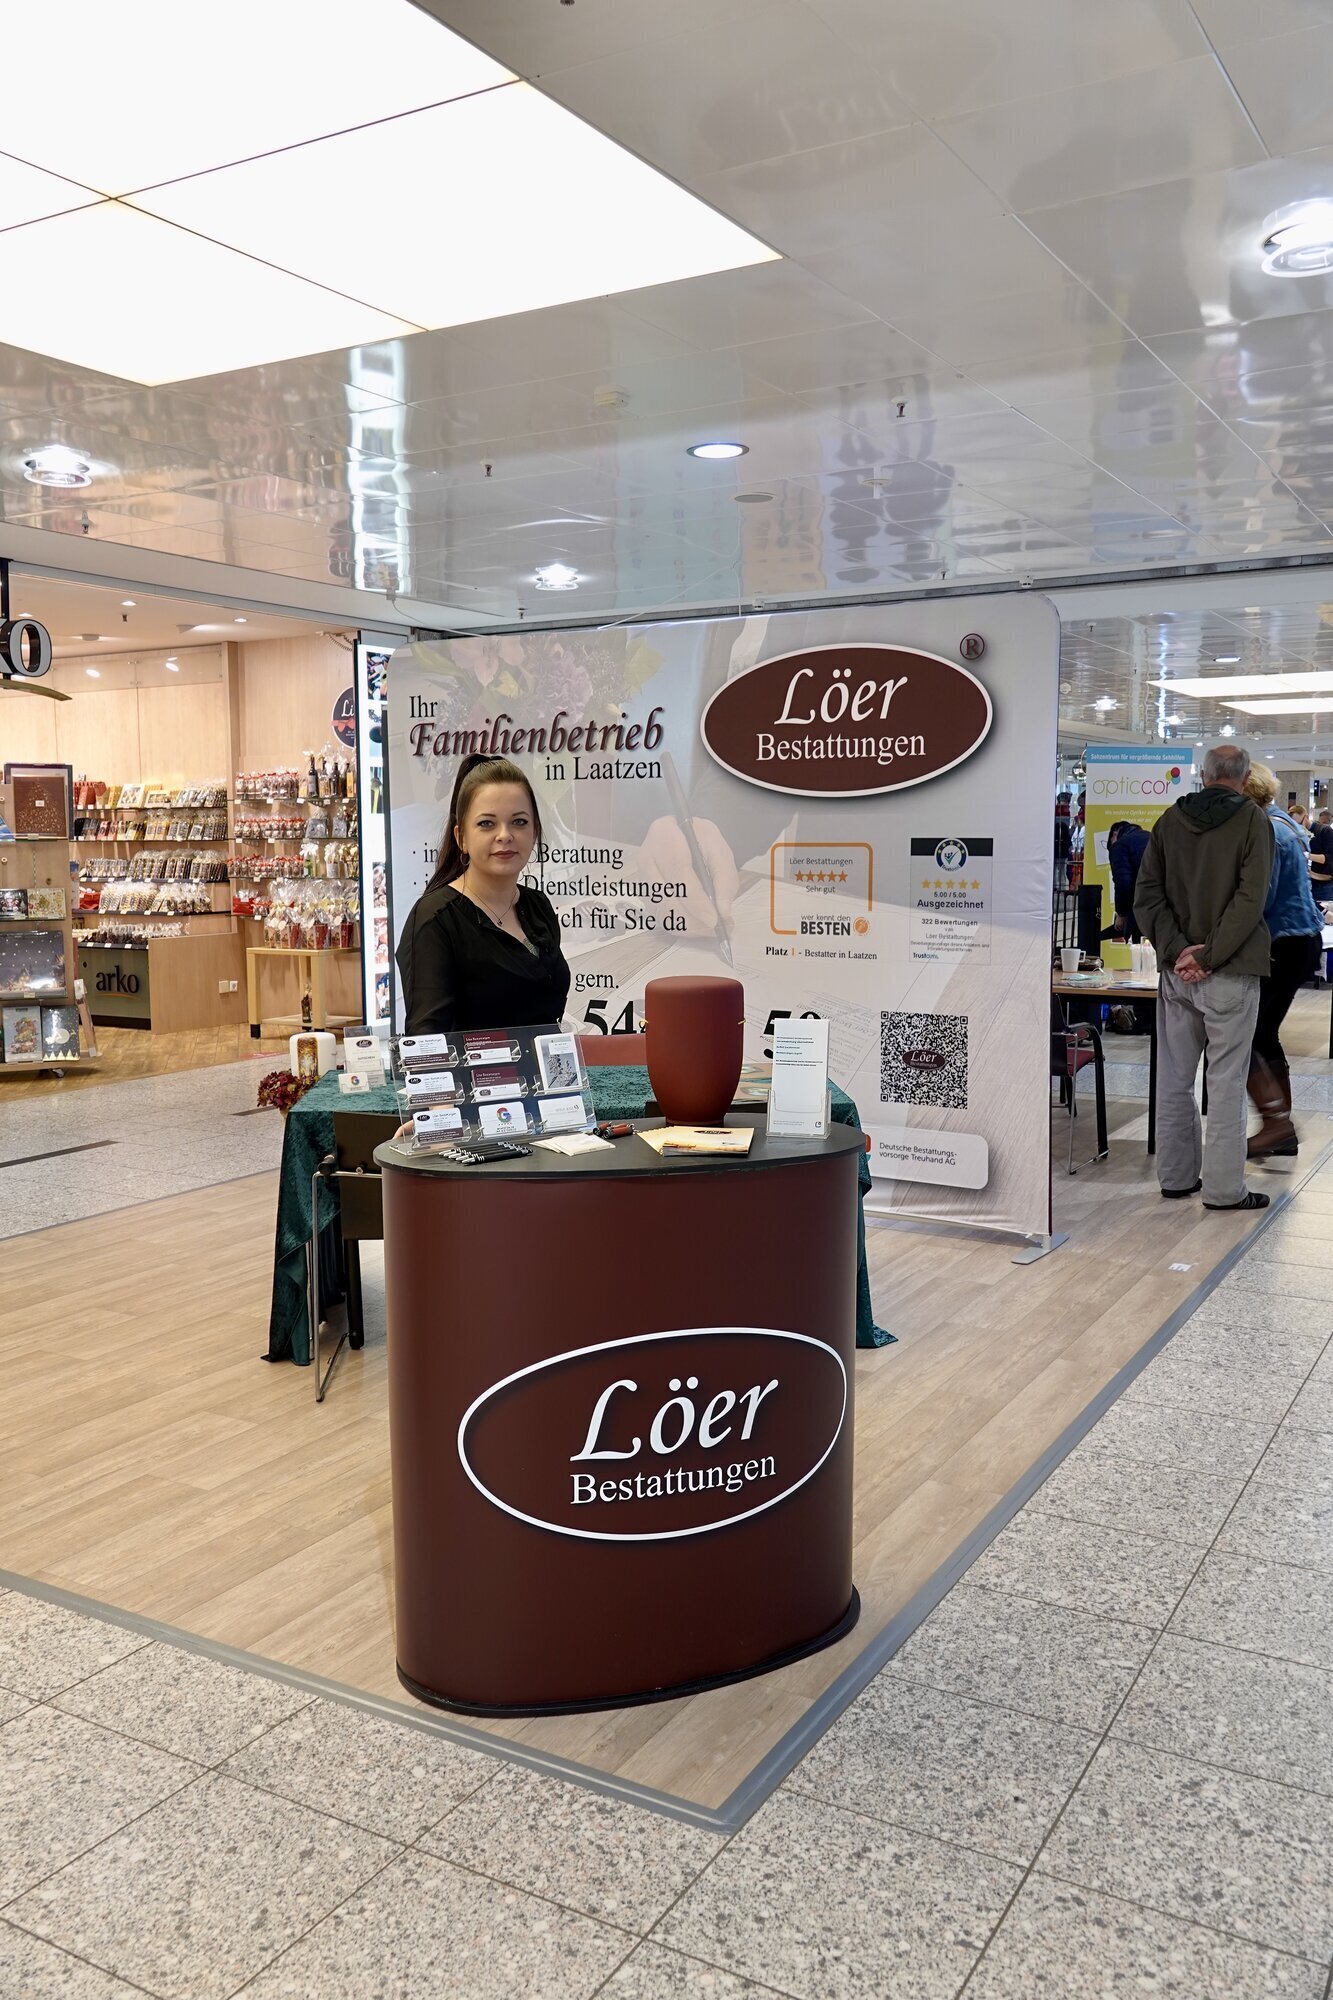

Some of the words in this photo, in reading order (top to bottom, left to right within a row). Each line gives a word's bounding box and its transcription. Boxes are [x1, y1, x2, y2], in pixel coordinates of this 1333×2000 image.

[409, 695, 439, 718] Ihr
[774, 667, 908, 725] Löer
[408, 706, 666, 757] Familienbetrieb
[756, 732, 926, 765] Bestattungen
[545, 757, 566, 780] in
[574, 756, 662, 780] Laatzen
[1092, 777, 1171, 798] opticcor
[536, 844, 624, 870] Beratung
[789, 857, 806, 865] Löer
[807, 857, 853, 867] Bestattungen
[523, 874, 688, 903] Dienstleistungen
[805, 885, 821, 893] Sehr
[822, 886, 836, 894] gut
[917, 899, 984, 910] Ausgezeichnet
[590, 907, 618, 929] für
[625, 909, 656, 930] Sie
[663, 909, 688, 931] da
[801, 921, 851, 936] BESTEN
[935, 919, 978, 927] Bewertungen
[765, 946, 788, 956] Platz
[804, 949, 837, 958] Bestatter
[838, 950, 846, 959] in
[848, 950, 877, 960] Laatzen
[96, 965, 139, 994] arko
[575, 973, 619, 992] gern.
[911, 1050, 937, 1062] Löer
[879, 1142, 912, 1152] Deutsche
[913, 1145, 957, 1158] Bestattungs-
[879, 1152, 910, 1161] vorsorge
[911, 1154, 944, 1164] Treuhand
[945, 1158, 956, 1166] AG
[570, 1376, 778, 1462] Löer
[570, 1455, 777, 1504] Bestattungen
